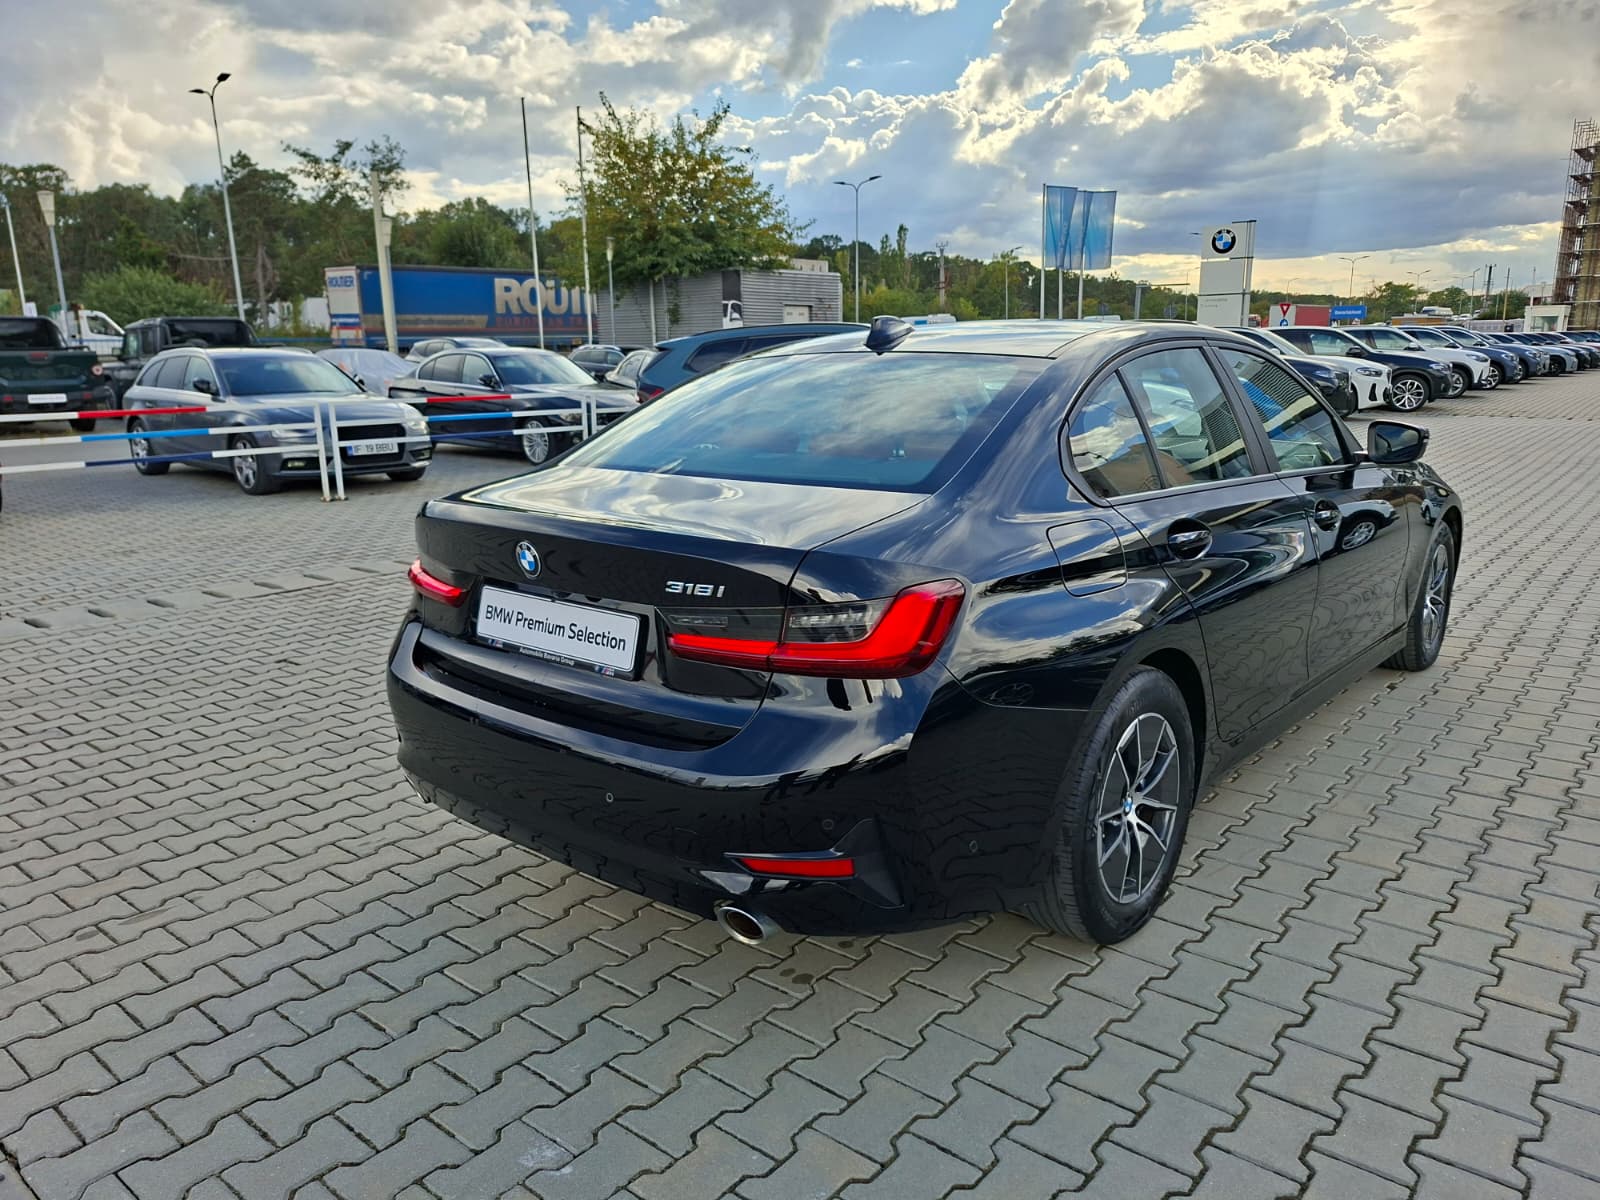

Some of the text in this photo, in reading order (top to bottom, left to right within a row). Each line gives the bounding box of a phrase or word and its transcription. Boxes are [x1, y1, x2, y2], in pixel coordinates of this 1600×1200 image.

[485, 604, 626, 651] BMW Premium Selection
[560, 656, 575, 666] Group
